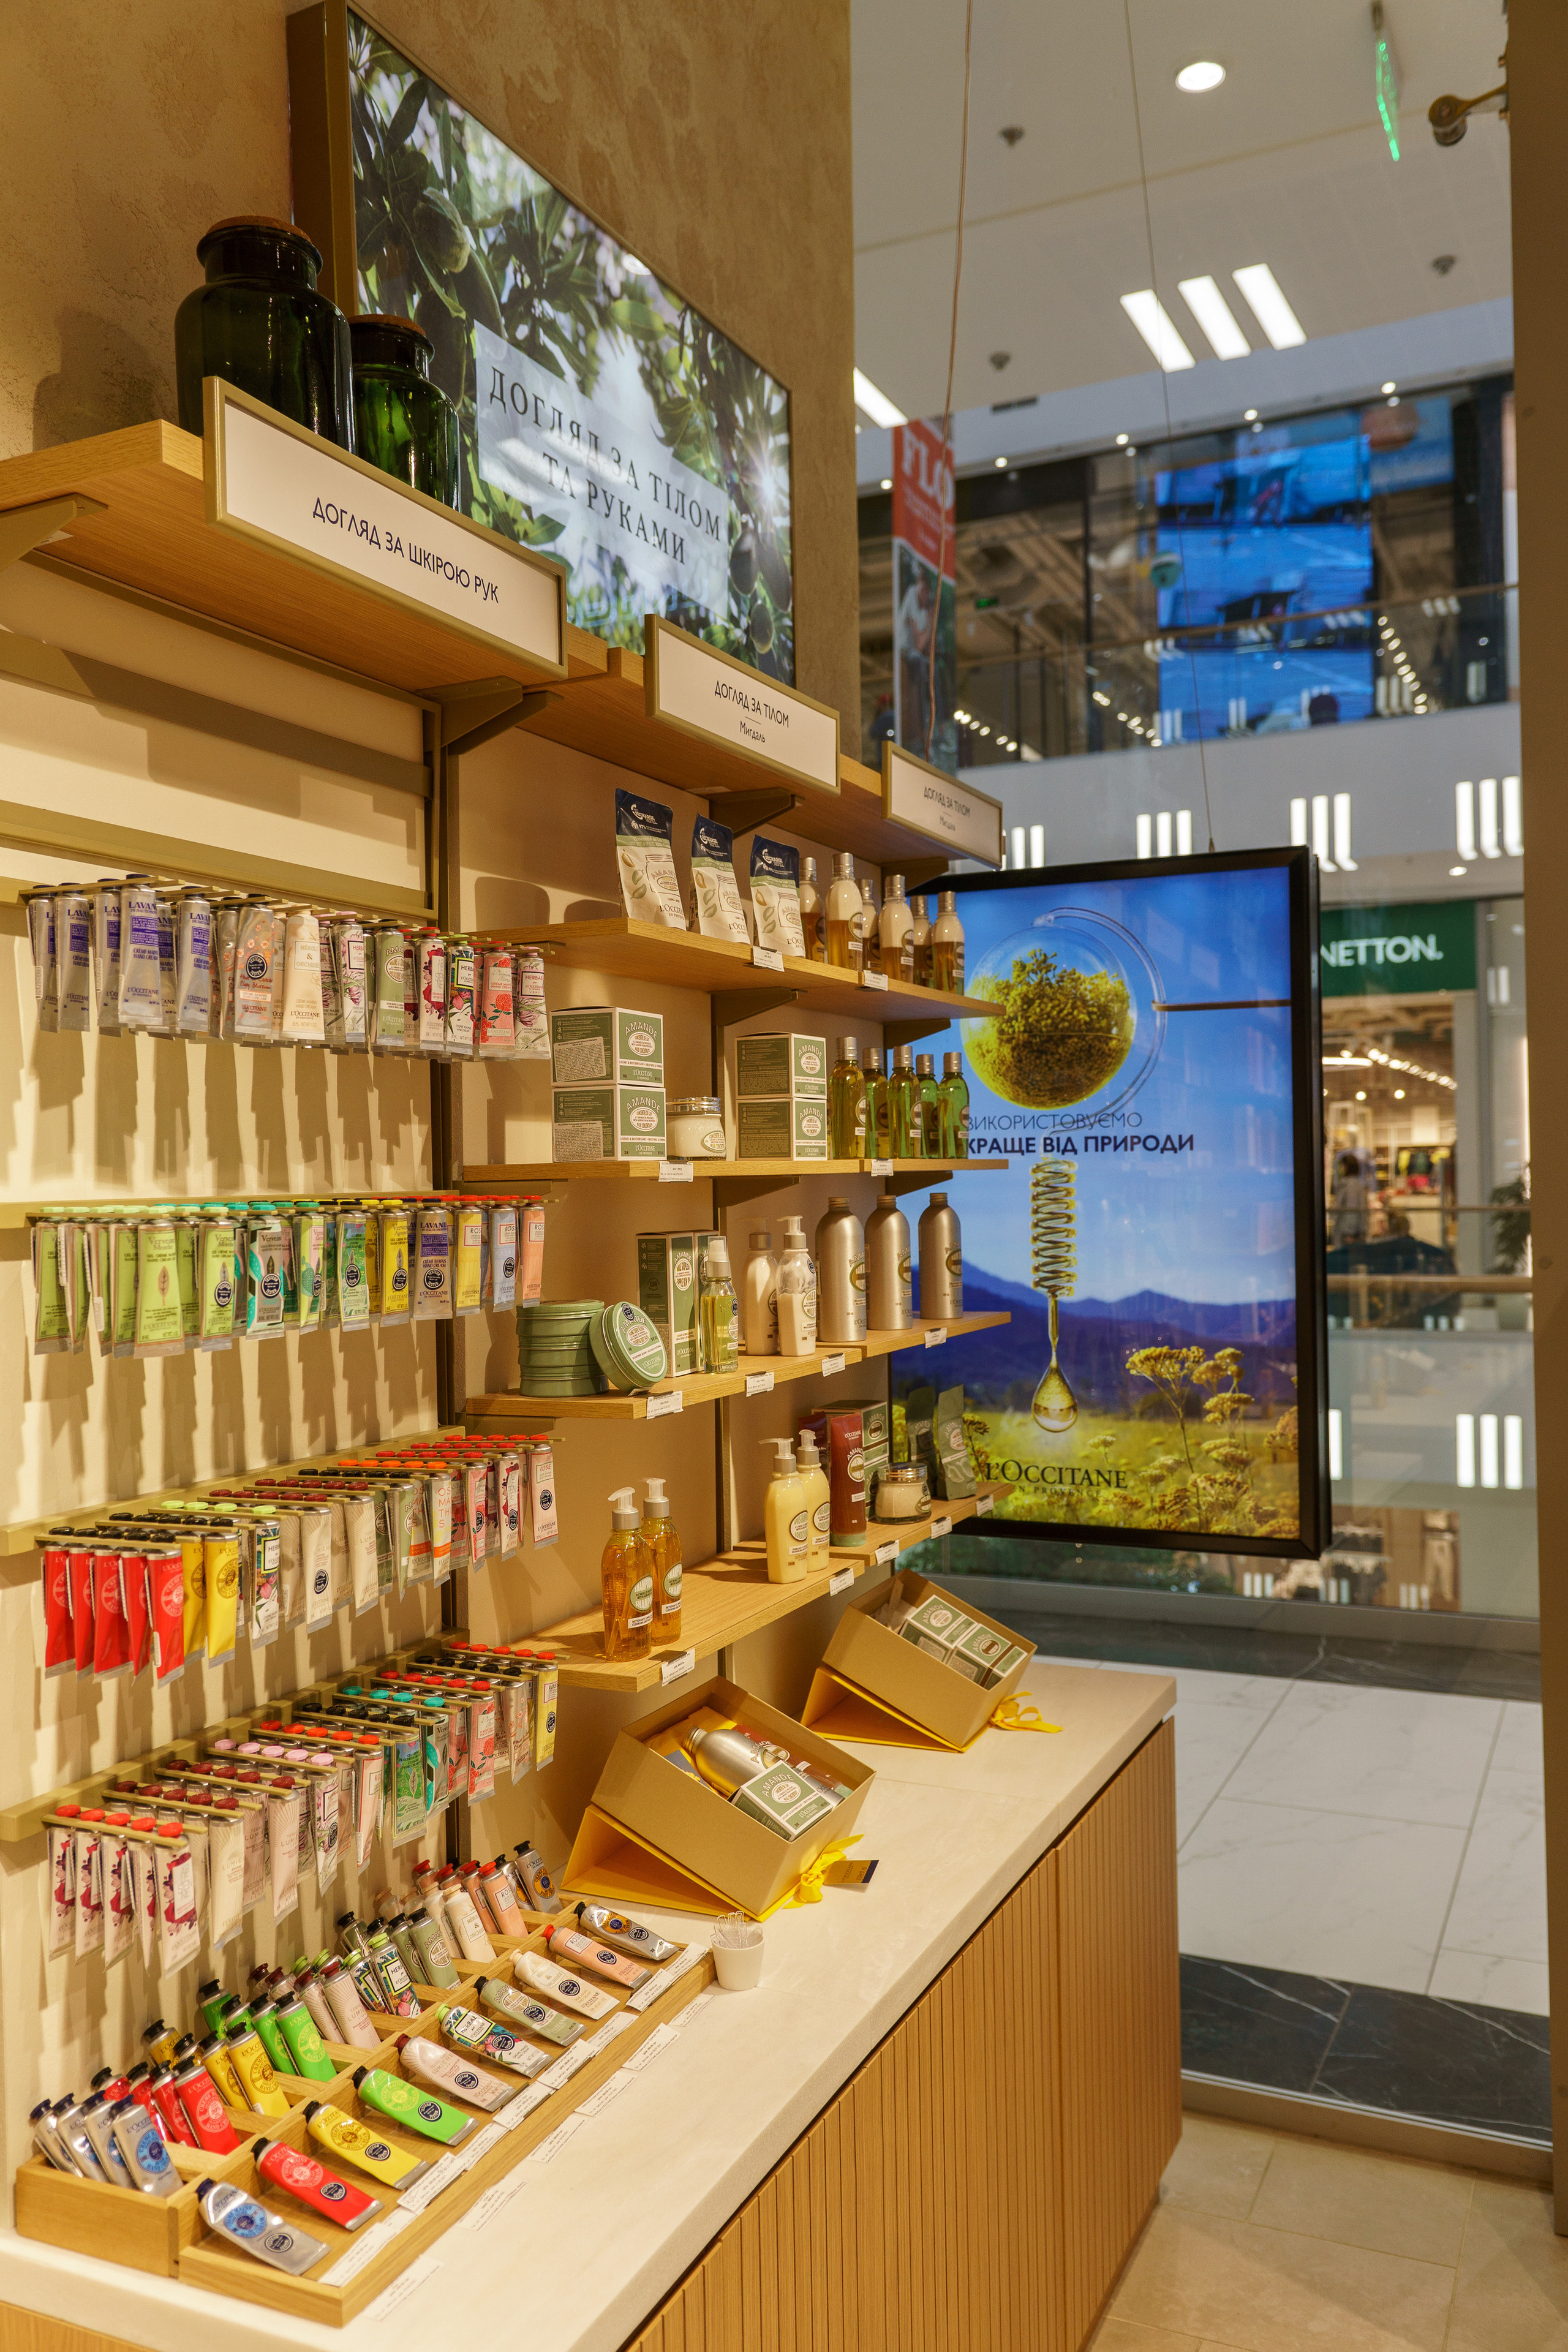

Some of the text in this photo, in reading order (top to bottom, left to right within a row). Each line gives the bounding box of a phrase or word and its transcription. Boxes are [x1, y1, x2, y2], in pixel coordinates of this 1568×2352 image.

[490, 366, 720, 541] ДОГЛЯД ЗА ТІЛОМ
[543, 452, 684, 564] ТА РУКАМИ
[313, 497, 499, 603] ДОГЛЯД ЗА ШКІРОЮ РУК
[715, 680, 788, 728] ДОГЛЯД ЗА ТІЛОМ
[740, 721, 765, 742] Мигдаль
[625, 1021, 658, 1040] AMANDE
[797, 1044, 823, 1060] AMANDE
[627, 1096, 660, 1114] AMANDE
[799, 1107, 823, 1121] AMANDE
[1044, 1137, 1077, 1155] ВІД
[1085, 1134, 1193, 1153] ПРИРОДИ
[674, 1251, 692, 1263] AMANDE
[986, 1460, 1127, 1488] L'OCCITANE
[761, 1774, 794, 1798] AMANDE
[799, 1803, 818, 1819] L'OCCITANE
[581, 1992, 600, 2008] L'OCCITANE
